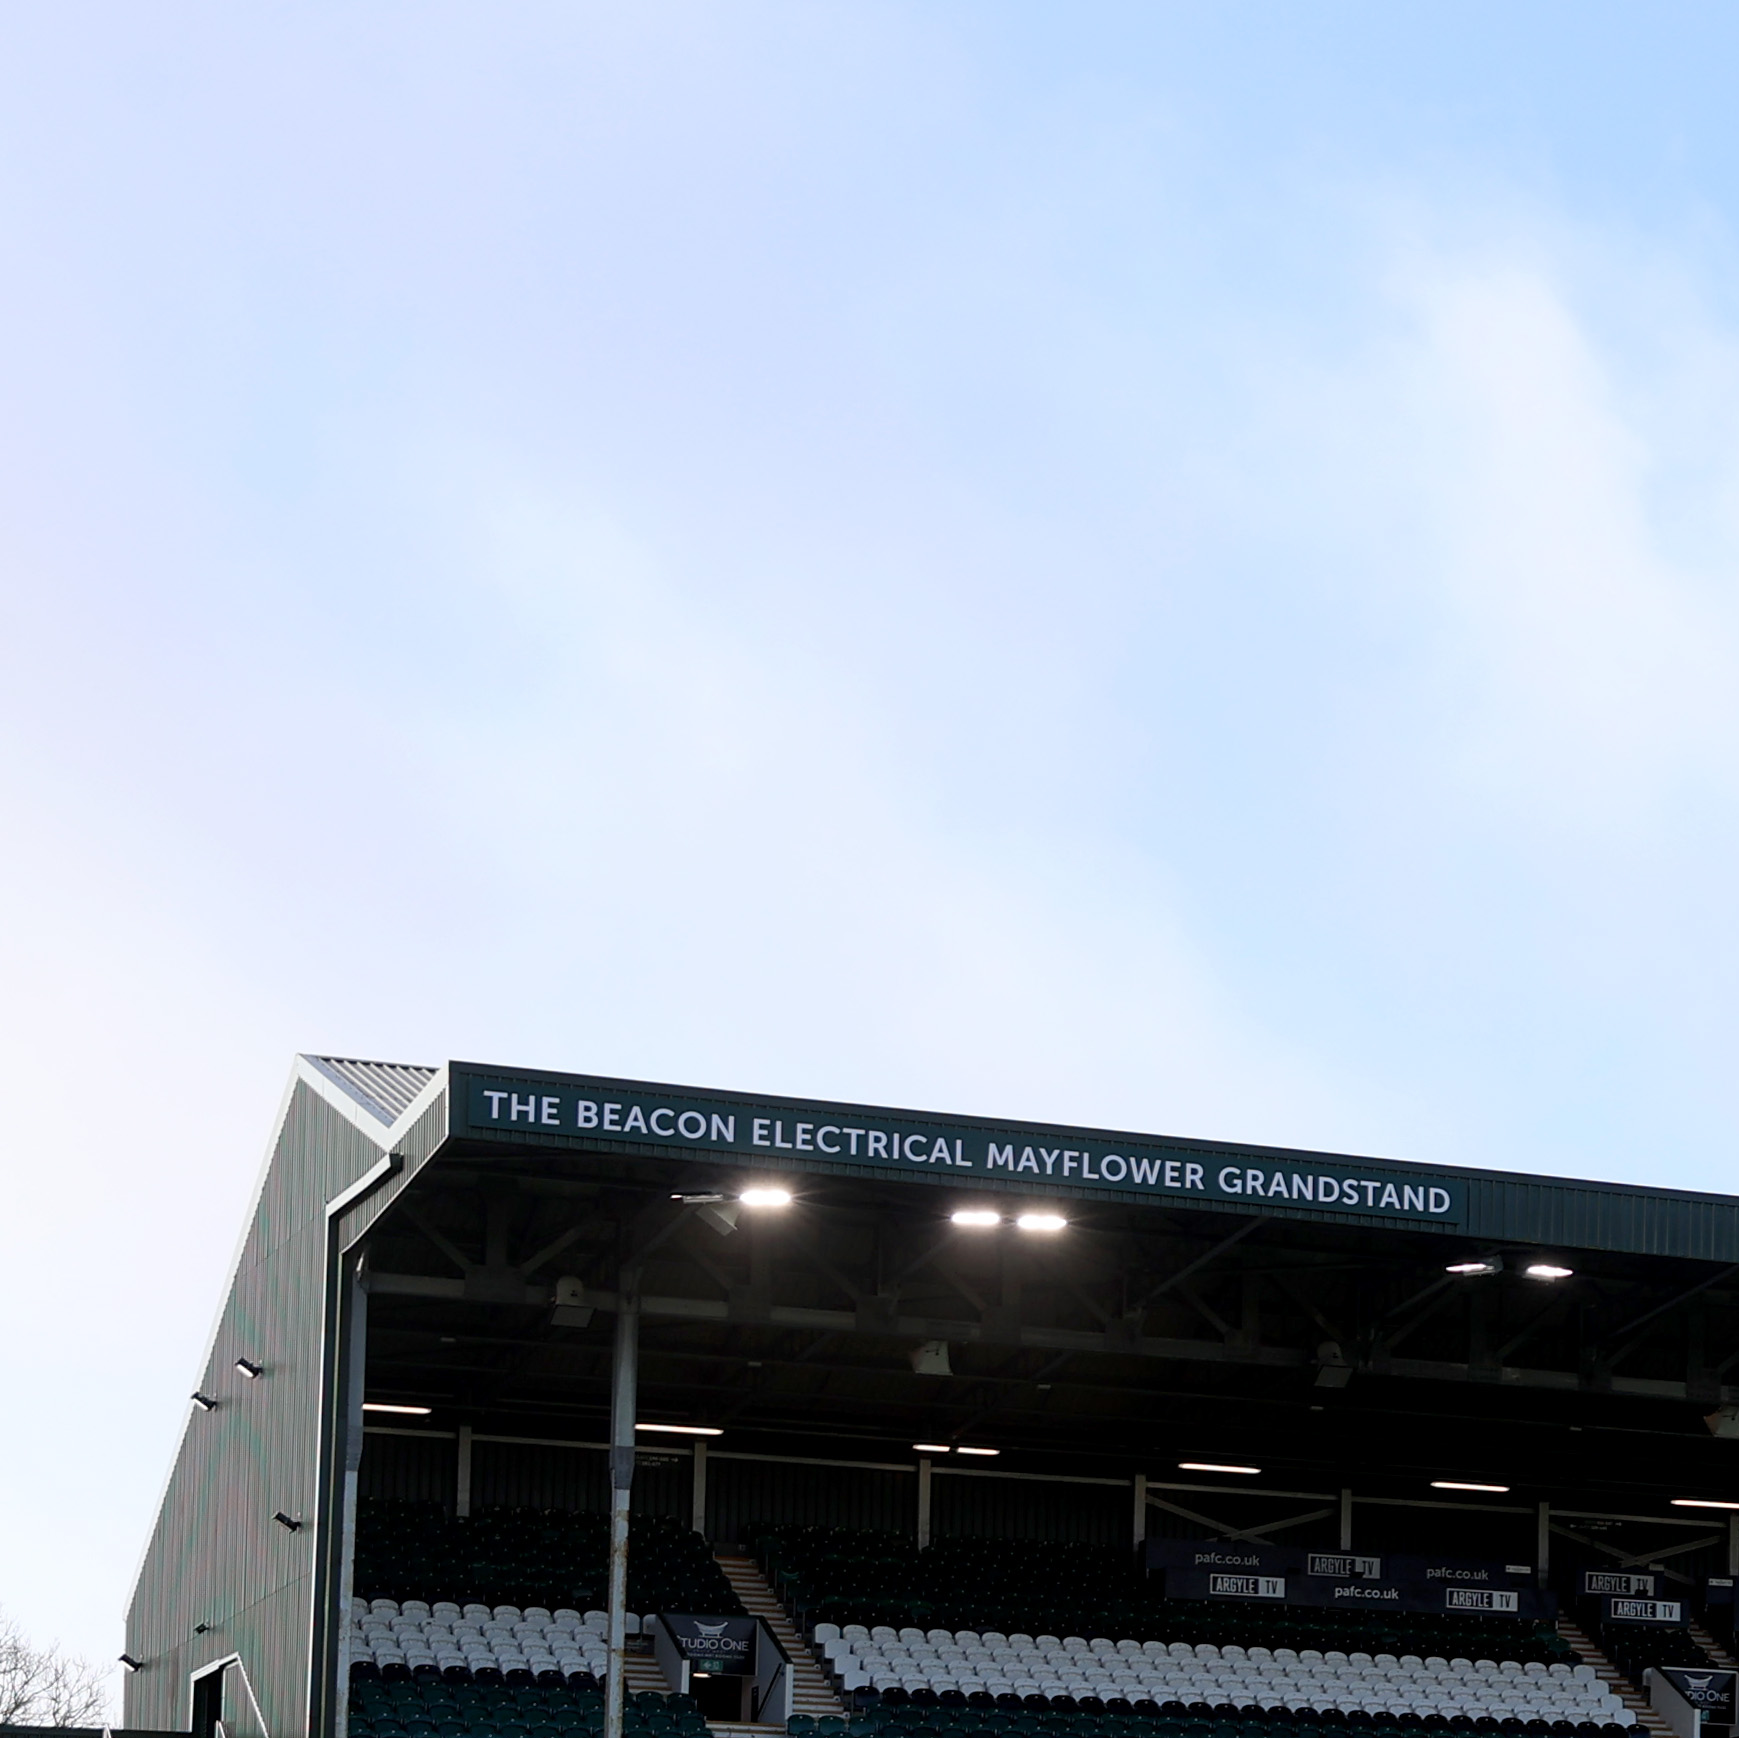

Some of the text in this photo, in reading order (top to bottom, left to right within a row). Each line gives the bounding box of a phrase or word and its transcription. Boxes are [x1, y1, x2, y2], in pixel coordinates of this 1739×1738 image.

[483, 1090, 1451, 1214] THE BEACON ELECTRICAL MAYFLOWER GRANDSTAND
[1195, 1552, 1260, 1567] pafc.co.uk
[1215, 1576, 1278, 1595] ARGYLE TV
[1335, 1585, 1399, 1600] pafc.co.uk
[1452, 1591, 1511, 1608] ARGYLE TV
[720, 1637, 750, 1651] ONE
